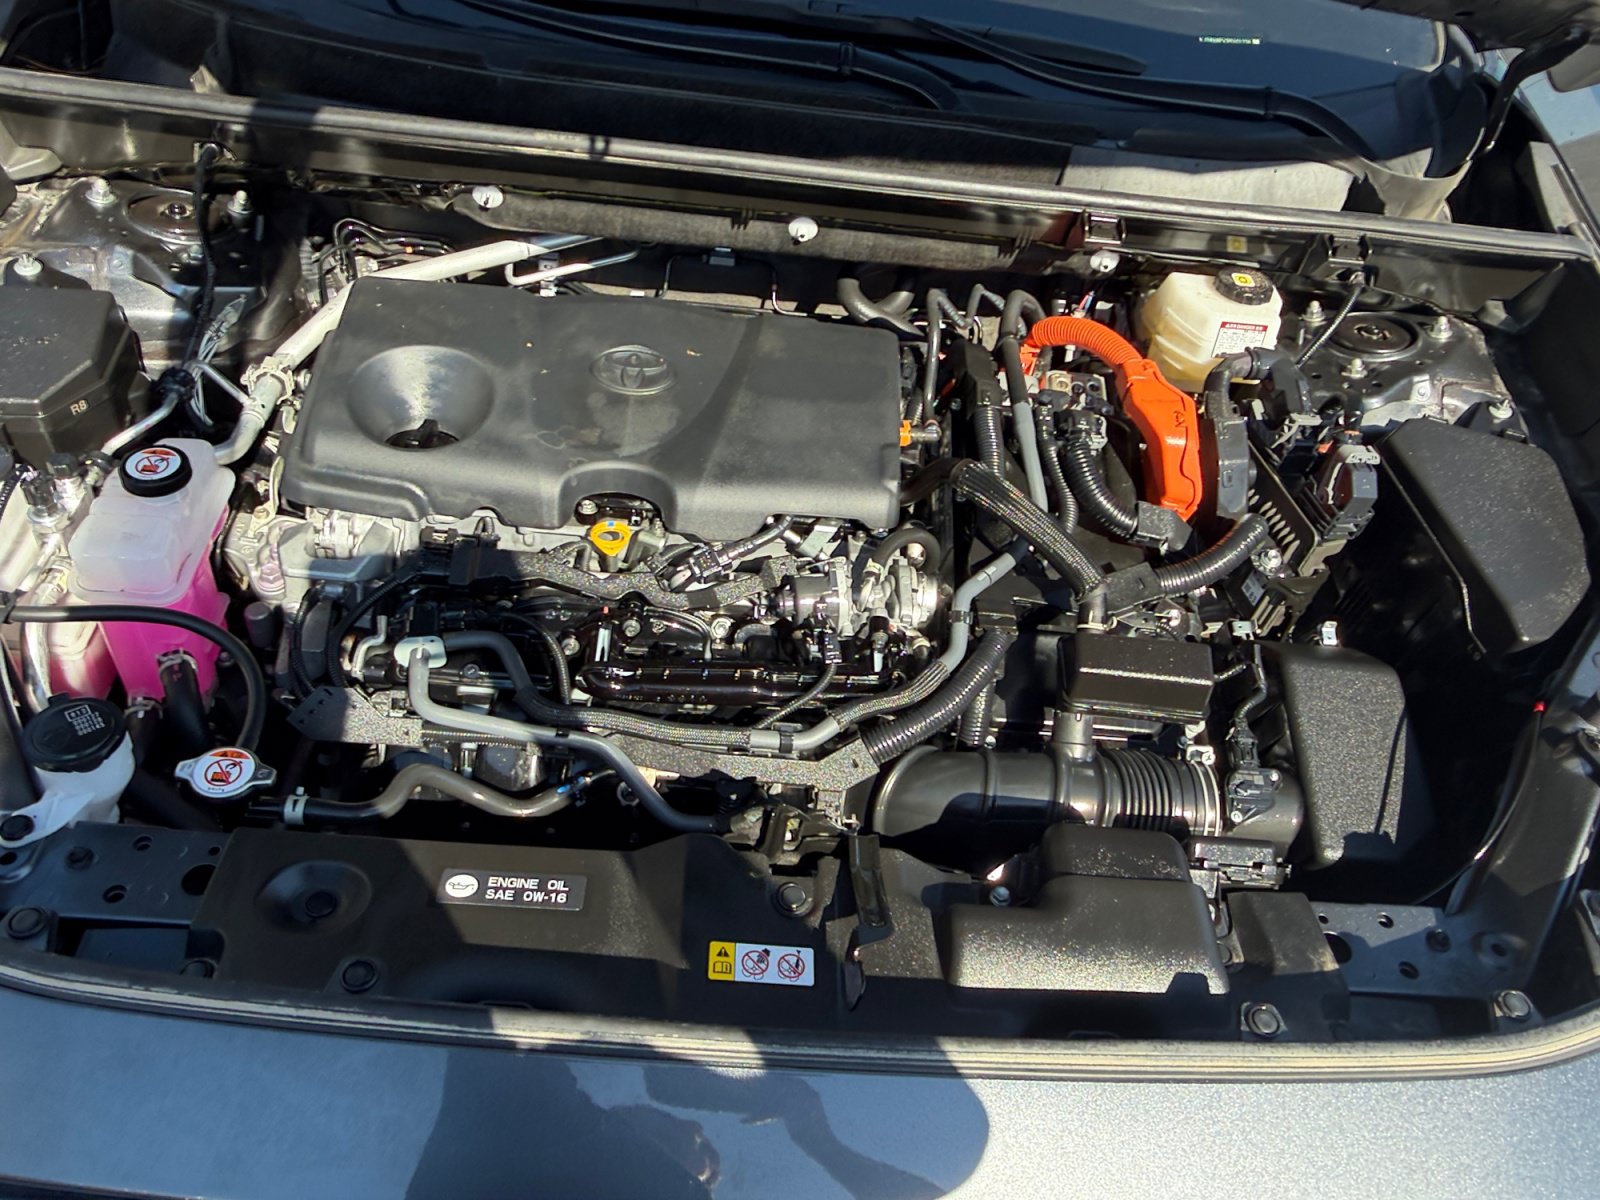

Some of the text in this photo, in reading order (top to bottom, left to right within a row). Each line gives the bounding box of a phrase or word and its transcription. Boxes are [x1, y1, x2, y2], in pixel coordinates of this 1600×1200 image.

[488, 877, 569, 891] ENGINE OIL
[485, 889, 567, 903] SAE 0W-16
